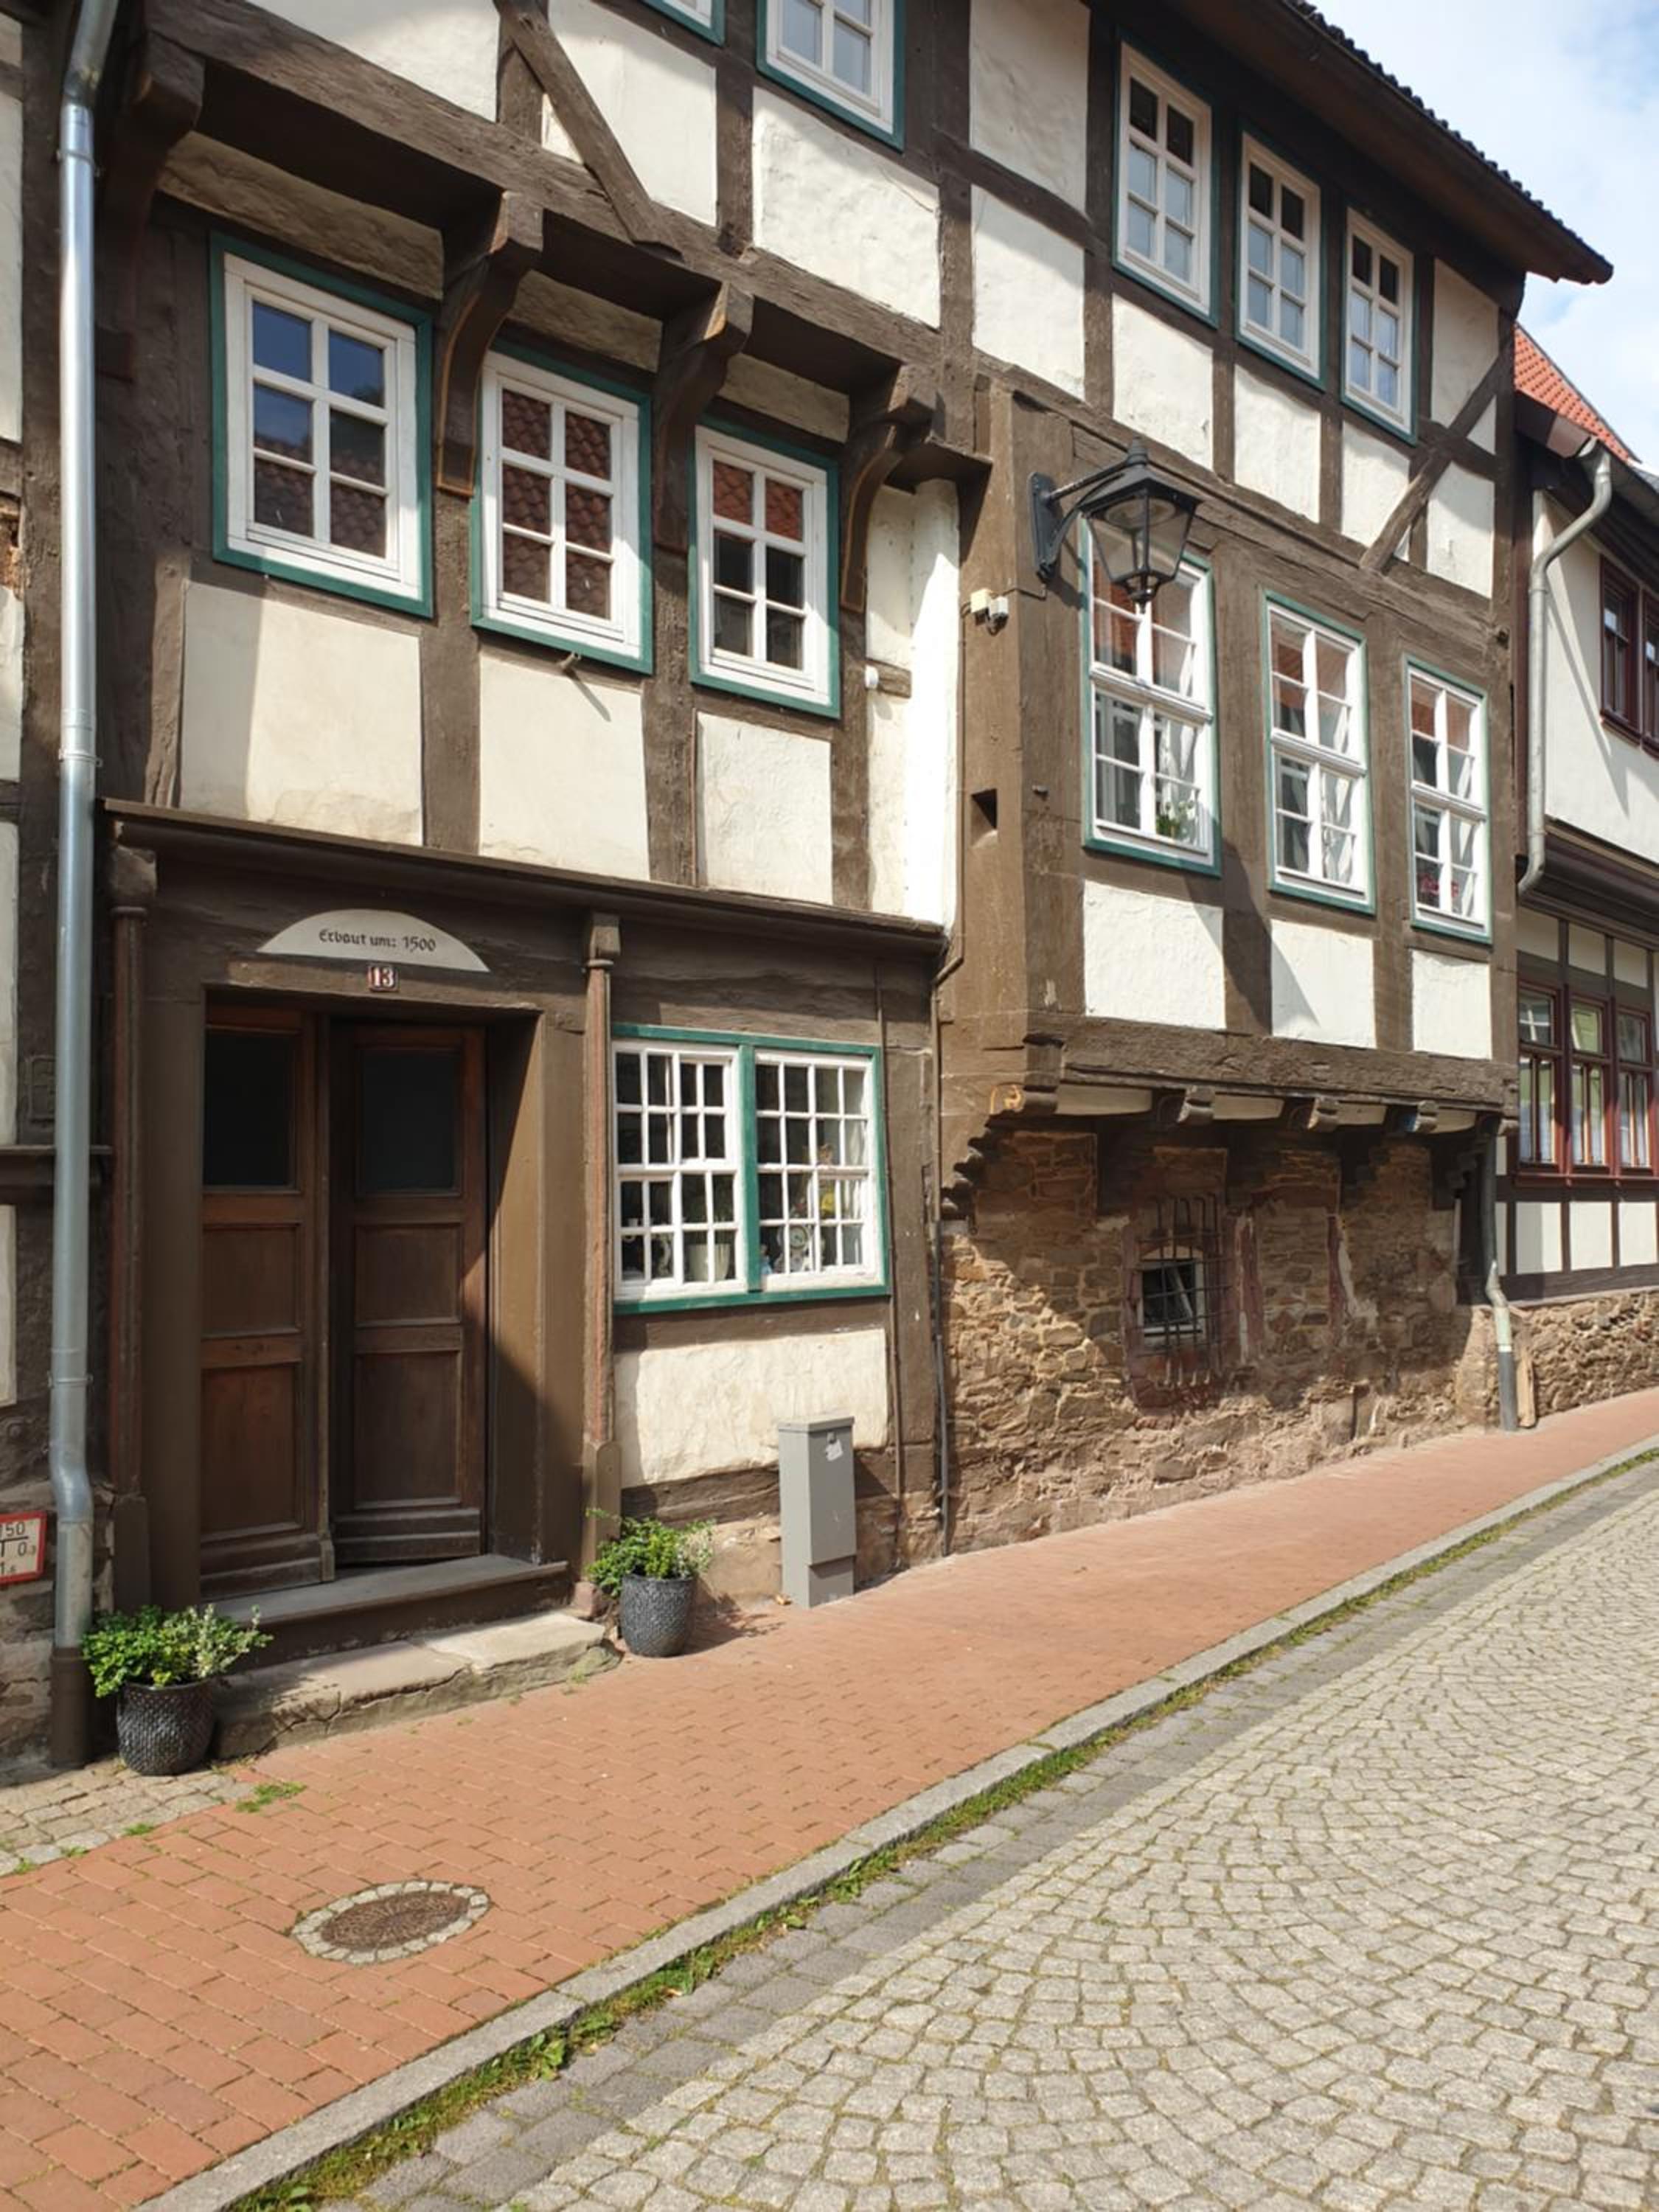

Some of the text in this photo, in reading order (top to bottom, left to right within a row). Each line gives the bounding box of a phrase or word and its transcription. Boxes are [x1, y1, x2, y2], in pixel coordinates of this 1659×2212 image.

[319, 928, 437, 952] Erbaut um: 1500
[373, 966, 395, 987] 13
